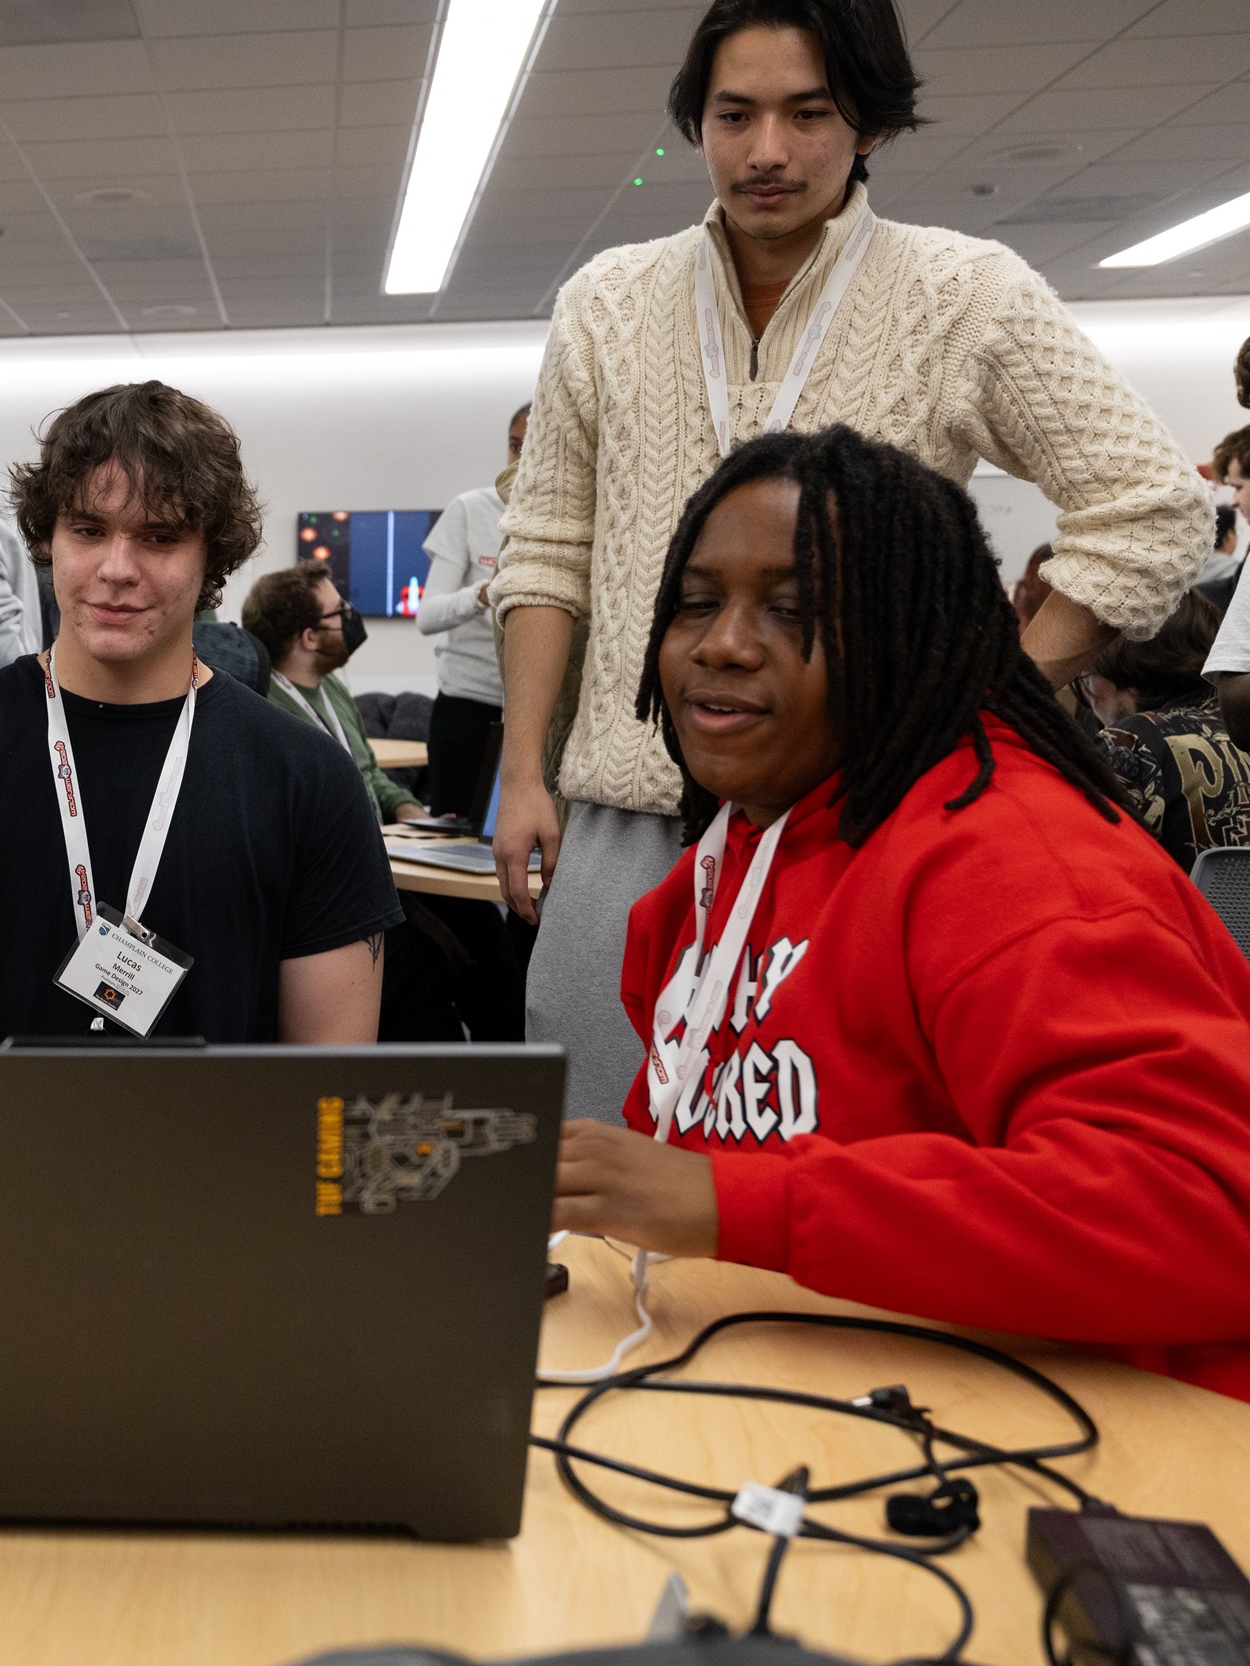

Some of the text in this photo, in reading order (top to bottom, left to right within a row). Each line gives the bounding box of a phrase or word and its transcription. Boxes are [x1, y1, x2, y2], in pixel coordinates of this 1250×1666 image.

[112, 933, 174, 975] CHAMPLAIN COLLEGE
[117, 951, 142, 972] Lucas
[95, 963, 111, 976] Game
[111, 973, 130, 987] Design
[129, 984, 144, 996] 2027
[112, 963, 136, 981] Merrill
